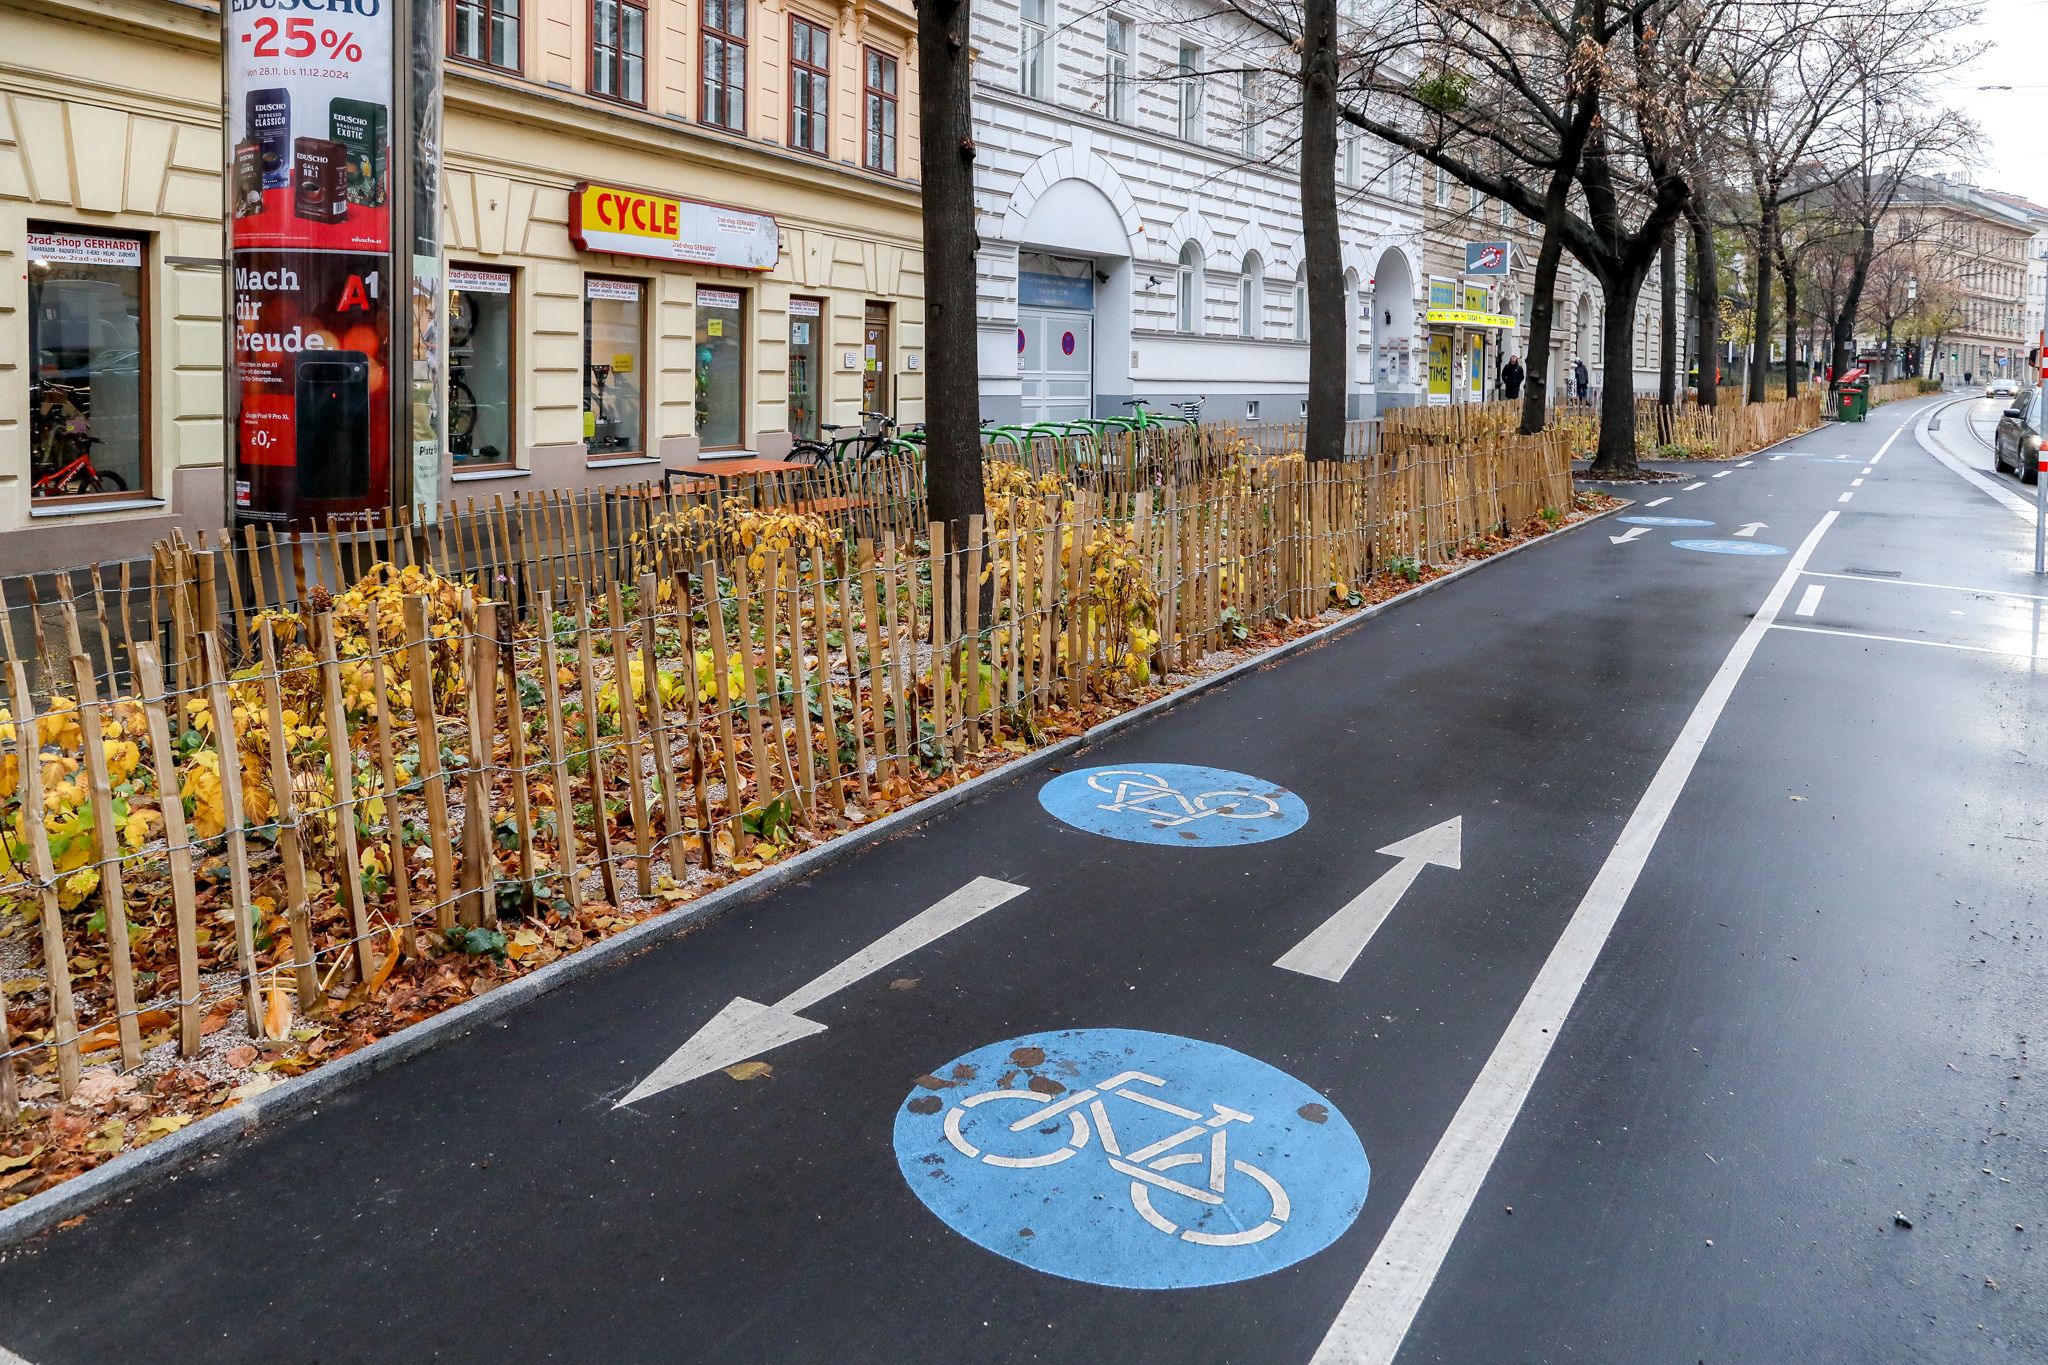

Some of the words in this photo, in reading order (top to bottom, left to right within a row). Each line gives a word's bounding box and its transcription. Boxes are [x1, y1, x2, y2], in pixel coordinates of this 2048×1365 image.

[241, 16, 363, 63] -25%
[259, 67, 281, 76] 28.11.
[283, 67, 297, 76] bis
[255, 103, 287, 112] EDUSCHO
[255, 117, 286, 127] CLASSICO
[333, 113, 368, 126] EDUSCHO
[336, 128, 363, 140] EXOTIC
[296, 152, 329, 164] EDUSCHO
[302, 163, 320, 171] GALA
[303, 169, 318, 178] NR.1
[596, 192, 679, 236] CYCLE
[27, 234, 81, 249] 2rad-shop
[84, 238, 140, 251] GERHARDT
[351, 236, 382, 244] eduscho.at
[41, 253, 126, 264] www.2rad-shop.at
[235, 267, 300, 291] Mach
[478, 272, 509, 282] GERHARDT
[588, 280, 612, 290] 2rad-shop
[336, 271, 379, 312] A1
[236, 294, 262, 321] dir
[237, 325, 334, 352] Freude.
[1429, 366, 1448, 382] TIME
